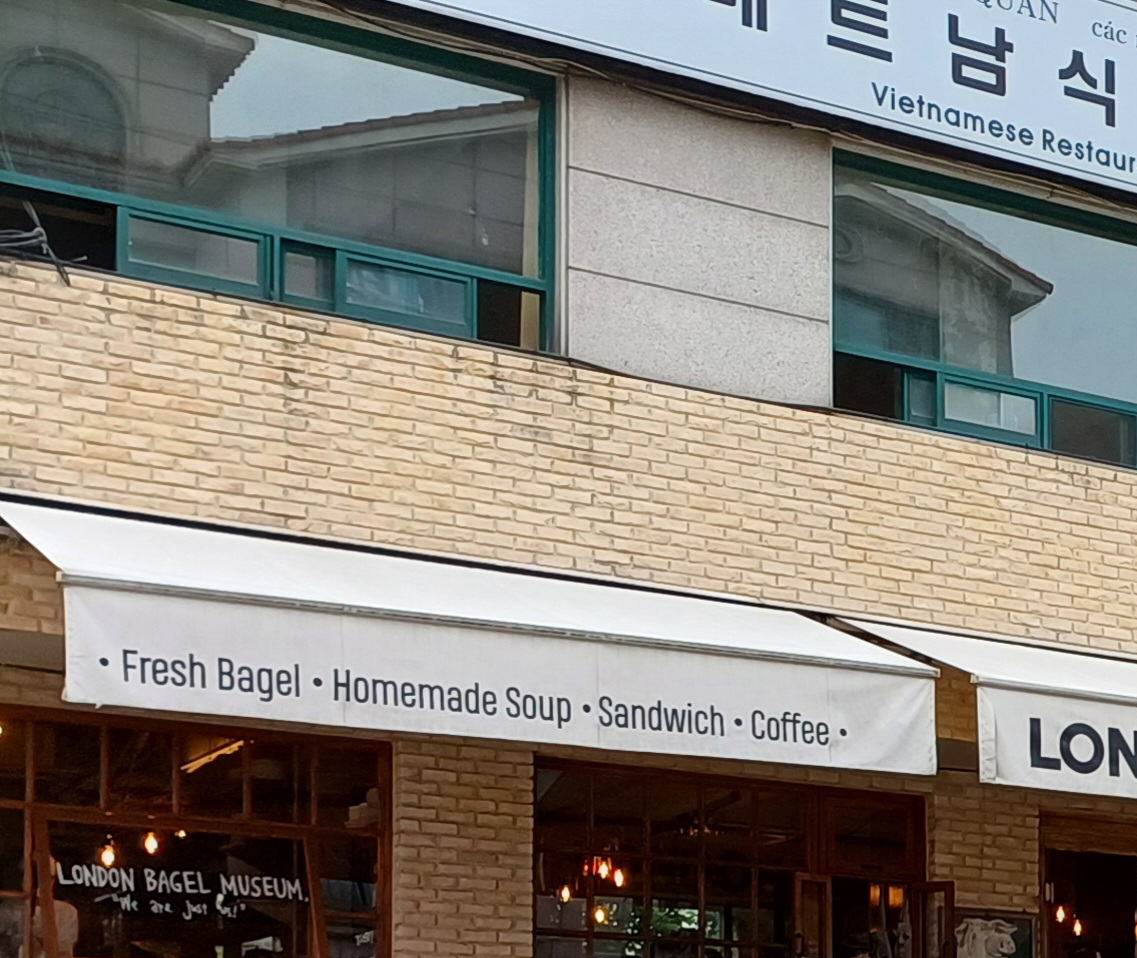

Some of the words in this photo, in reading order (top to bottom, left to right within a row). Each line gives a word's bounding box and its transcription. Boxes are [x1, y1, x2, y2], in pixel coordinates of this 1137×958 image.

[1091, 18, 1127, 45] các
[870, 81, 1034, 146] Vietnamese
[122, 648, 206, 689] Fresh
[217, 657, 301, 702] Bagel
[332, 668, 498, 716] Homemade
[505, 686, 572, 729] Soup
[598, 695, 726, 737] Sandwich
[750, 710, 830, 746] Coffee
[57, 861, 135, 892] LONDON
[144, 868, 211, 895] BAGEL
